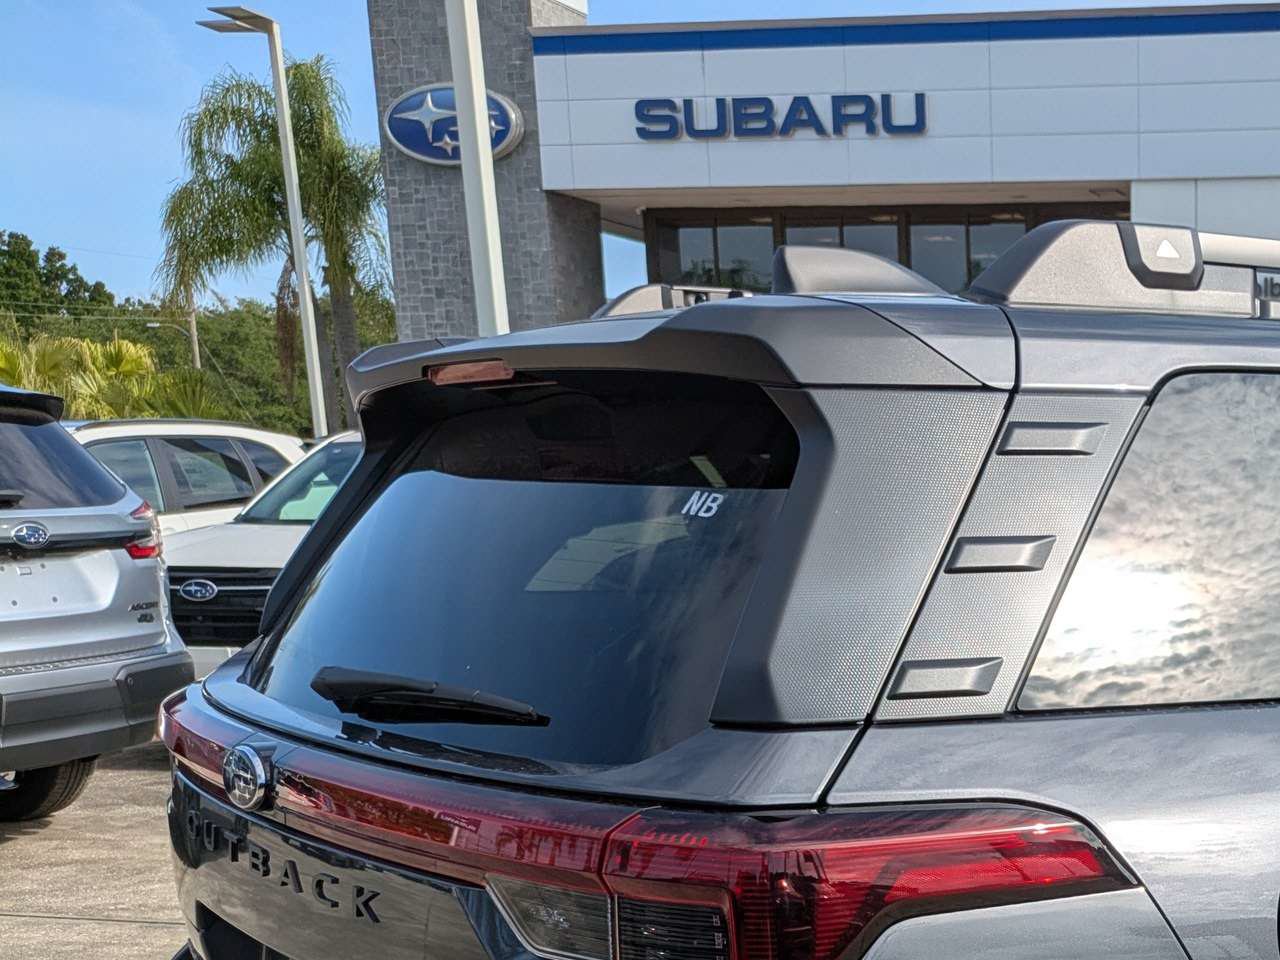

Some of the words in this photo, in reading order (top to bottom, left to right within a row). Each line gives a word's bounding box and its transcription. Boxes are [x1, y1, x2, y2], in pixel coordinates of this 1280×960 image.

[634, 92, 927, 141] SUBARU
[680, 490, 724, 518] NB
[187, 809, 382, 925] OUTBACK
